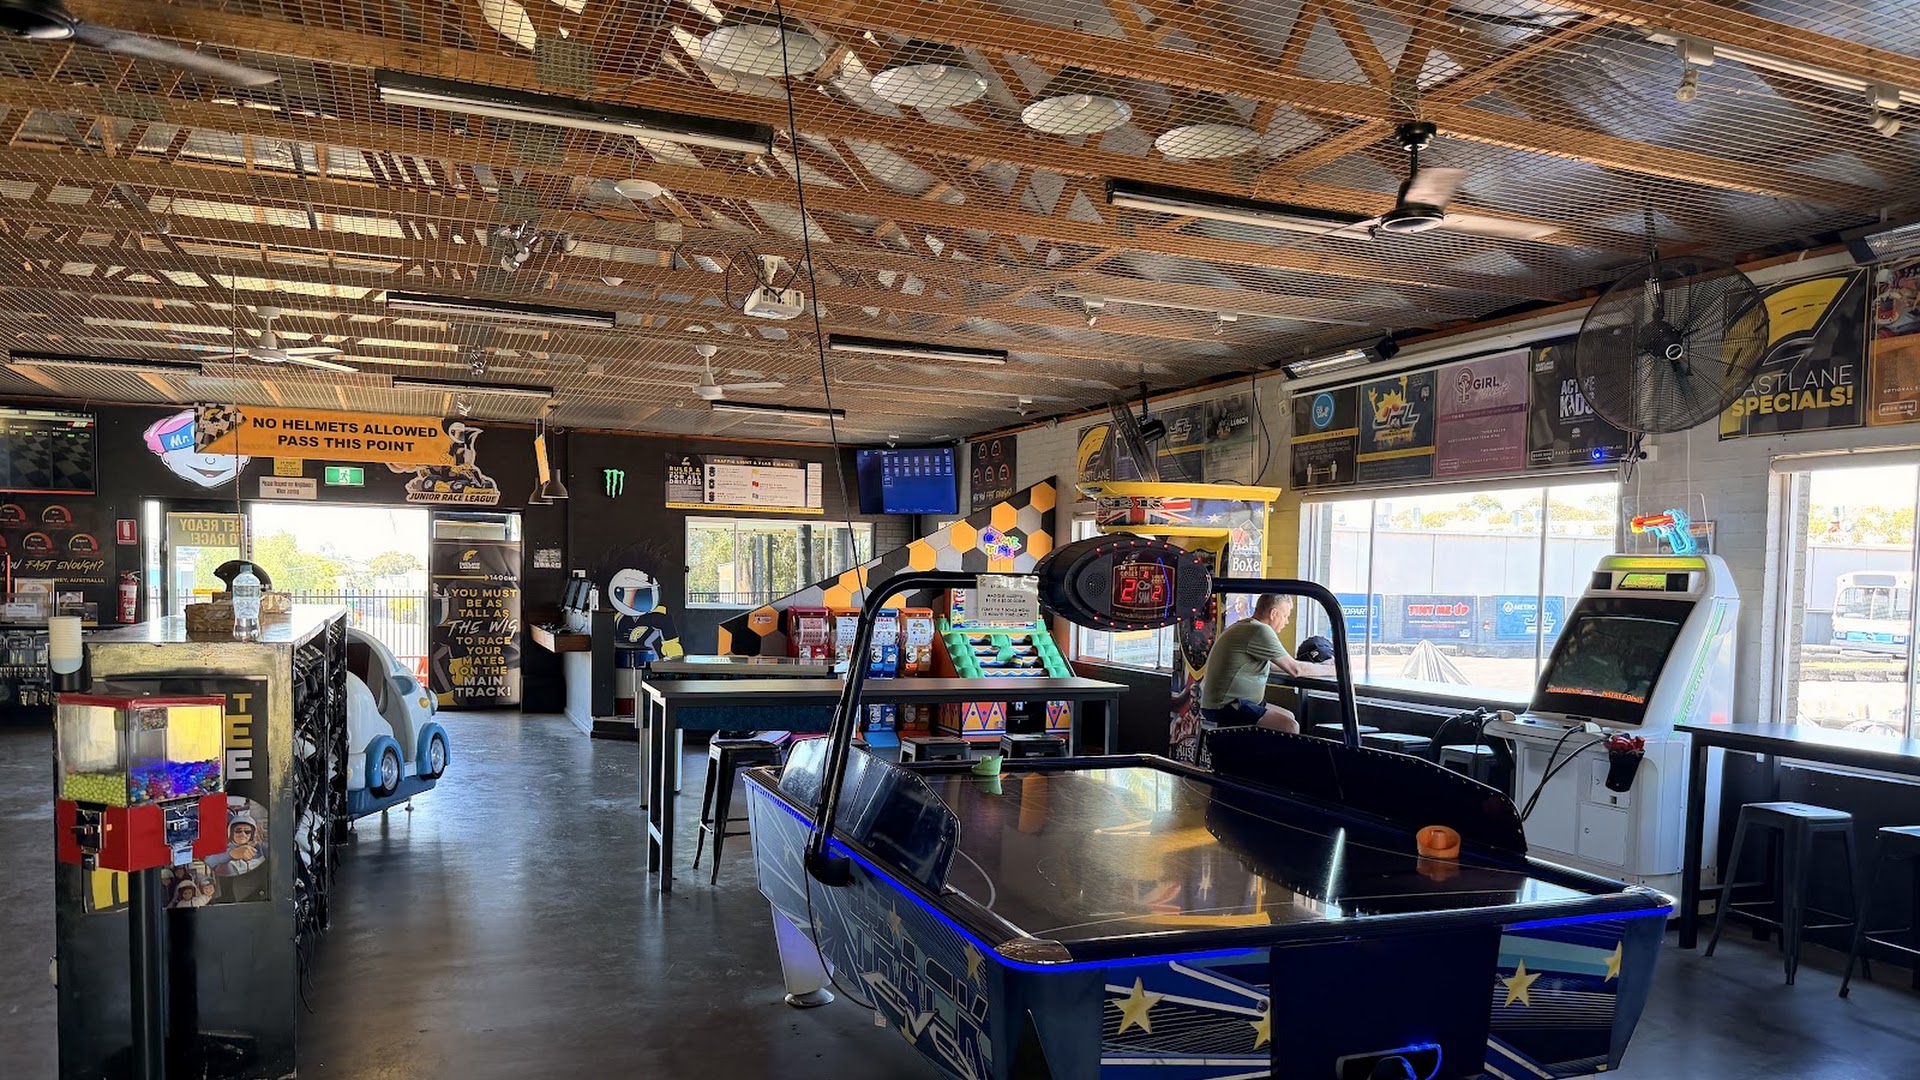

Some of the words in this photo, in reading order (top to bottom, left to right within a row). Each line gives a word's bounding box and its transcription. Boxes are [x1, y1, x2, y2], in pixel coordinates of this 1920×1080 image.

[1473, 376, 1500, 390] GIRL
[1737, 364, 1853, 397] ASTLANE
[1730, 385, 1853, 418] SPECIALS!
[253, 417, 277, 429] NO
[282, 419, 358, 433] HELMETS
[363, 424, 438, 438] ALLOWED
[1230, 416, 1248, 427] LUNCH
[278, 435, 319, 448] PASS
[324, 437, 362, 450] THIS
[366, 440, 415, 452] POINT
[410, 492, 440, 500] JUNIOR
[441, 493, 462, 502] RACE
[464, 494, 496, 503] LEAGUE
[984, 534, 1020, 546] GAME
[985, 544, 1015, 558] TIME
[25, 559, 56, 572] FAST
[56, 558, 105, 574] ENOUGH?
[451, 589, 478, 598] YOU
[482, 589, 518, 598] MUST
[1122, 579, 1137, 600] 2
[1152, 585, 1162, 600] 2
[466, 599, 482, 607] BE
[486, 599, 502, 607] AS
[1408, 604, 1434, 616] TINT
[1435, 604, 1452, 616] ME
[1453, 602, 1470, 616] UP
[459, 609, 490, 617] TALL
[493, 609, 510, 617] AS
[448, 620, 482, 637] THE
[489, 615, 518, 639] WIG
[456, 637, 473, 645] TO
[478, 637, 512, 645] RACE
[463, 656, 504, 665] MATES
[460, 666, 478, 675] ON
[483, 666, 507, 675] THE
[464, 677, 503, 685] MAIN
[455, 687, 511, 697] TRACK!
